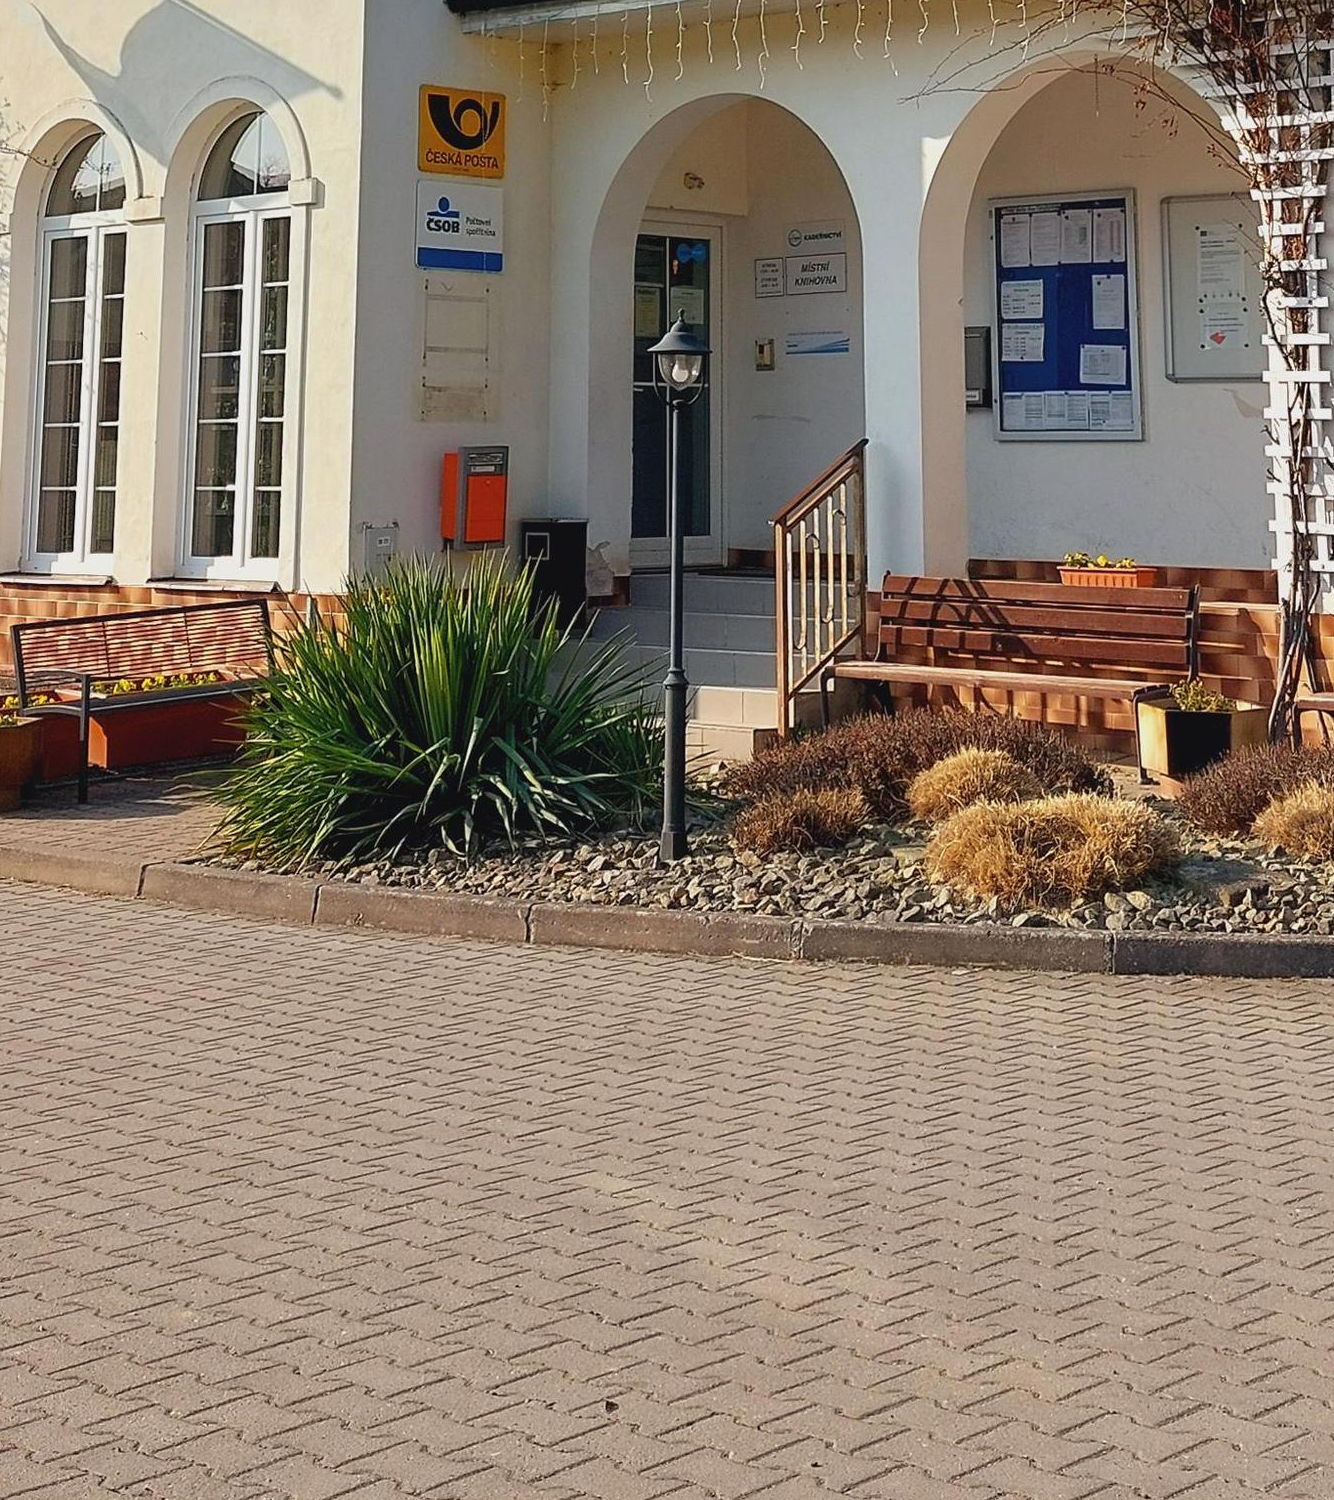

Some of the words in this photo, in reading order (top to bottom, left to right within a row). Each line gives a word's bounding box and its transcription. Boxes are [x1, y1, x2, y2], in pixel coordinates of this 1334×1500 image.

[426, 148, 462, 165] ČESKÁ
[464, 153, 499, 169] POŠTA
[426, 217, 460, 233] ČSOB
[801, 260, 830, 273] MÍSTNÍ
[794, 275, 837, 287] KNIHOVNA
